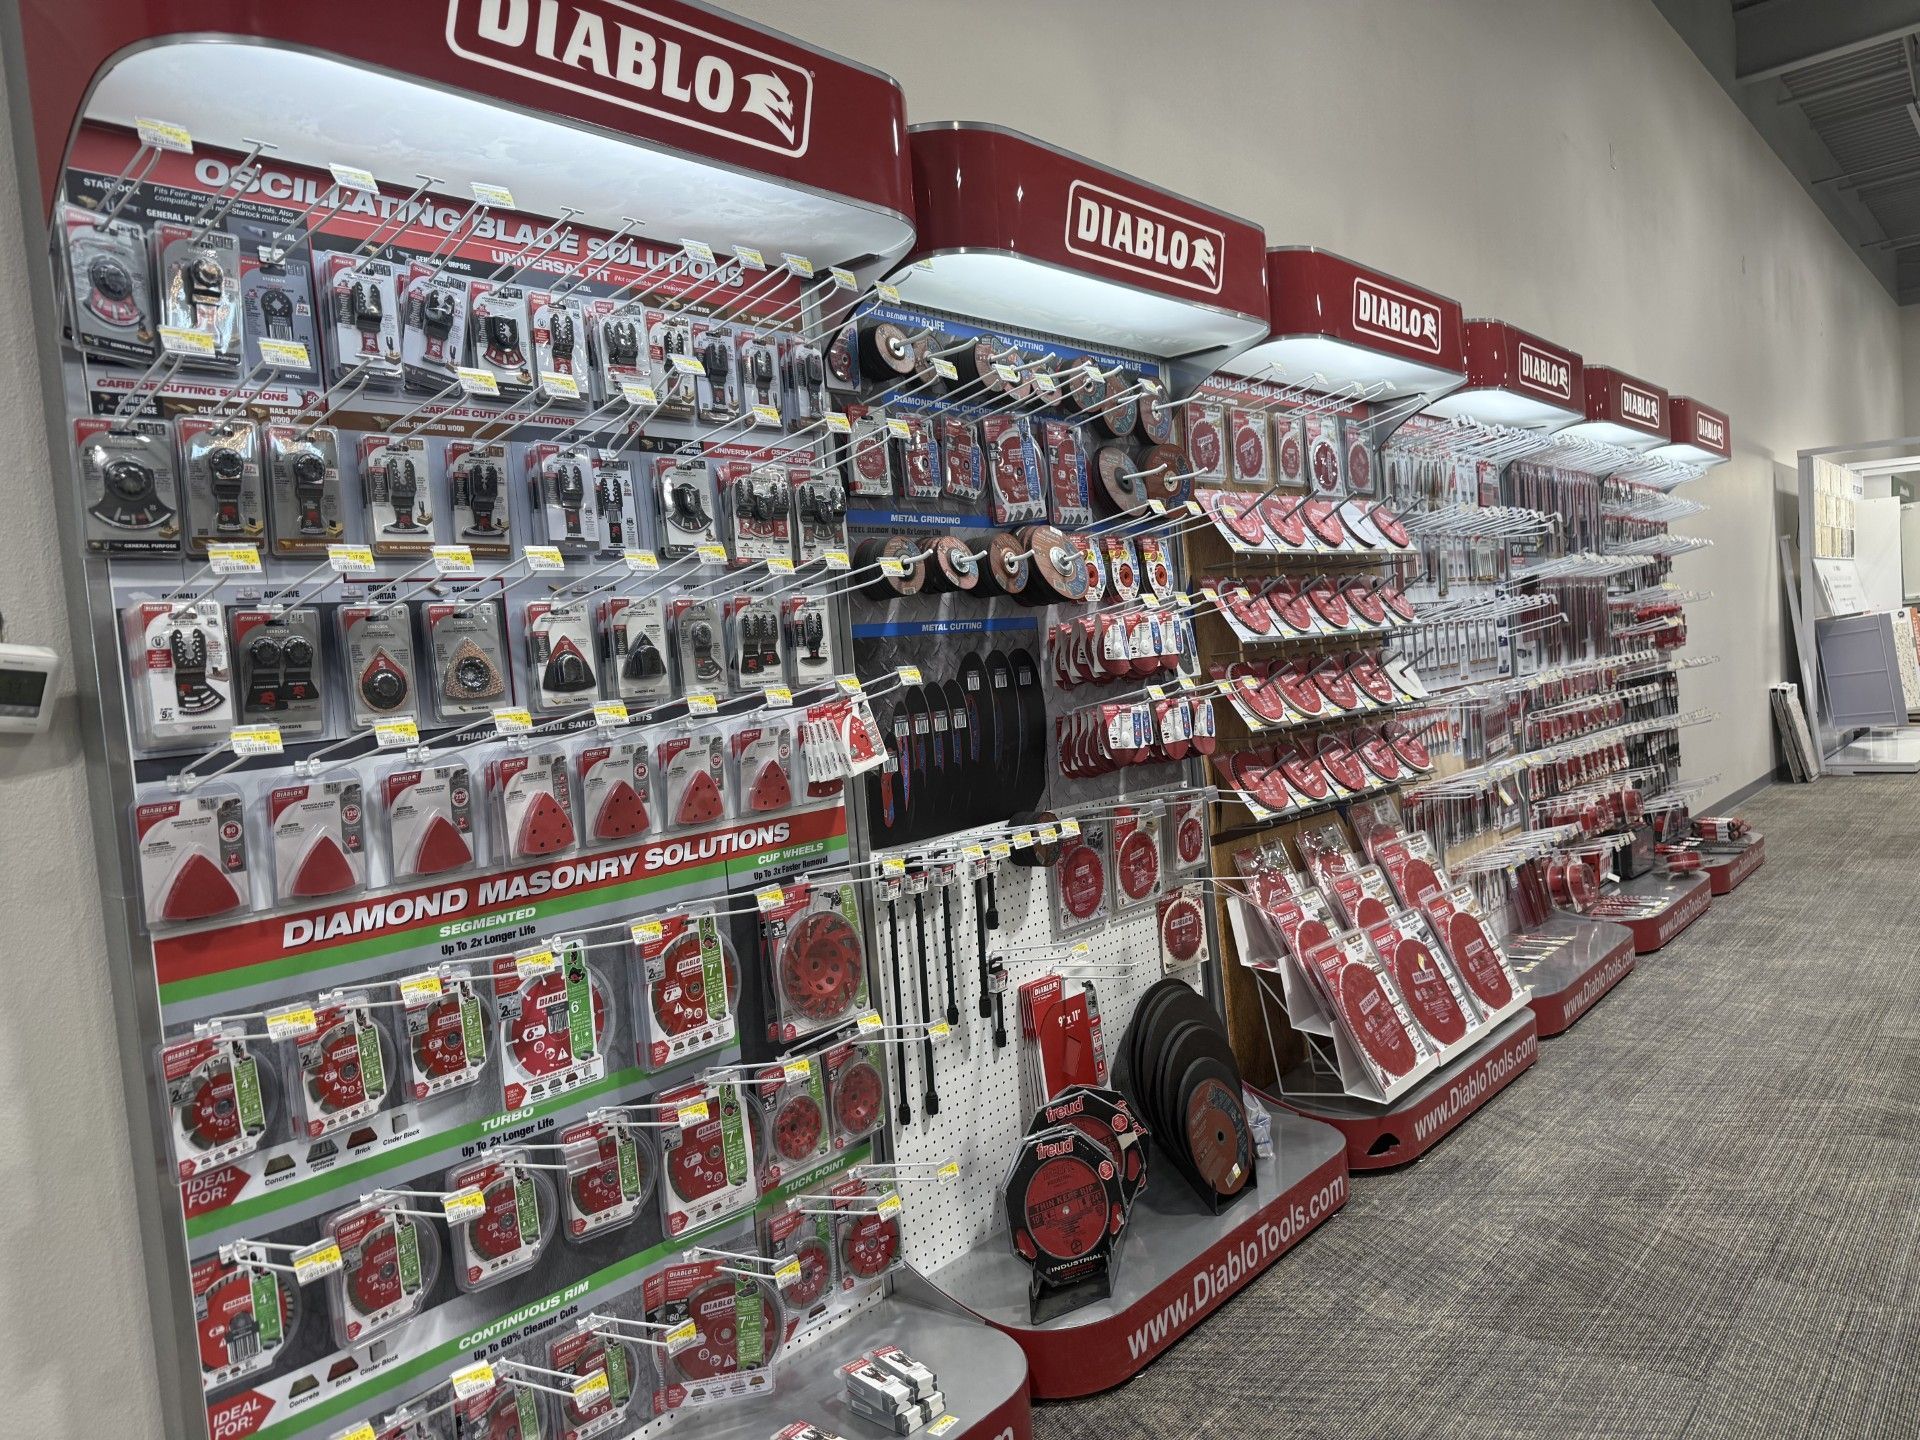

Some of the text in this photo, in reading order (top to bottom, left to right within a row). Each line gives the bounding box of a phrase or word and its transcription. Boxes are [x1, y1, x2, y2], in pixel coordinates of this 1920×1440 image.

[477, 0, 735, 114] DIABLO
[146, 208, 183, 223] GENERAL
[154, 186, 170, 197] Fits
[279, 209, 294, 218] Also
[195, 158, 745, 288] OSCILLATING BLADE SOLUTIONS
[1078, 196, 1189, 270] DIABLO
[492, 250, 585, 278] UNIVERSAL
[931, 320, 945, 332] LIFE
[1359, 289, 1422, 338] DIABLO
[1013, 338, 1044, 352] CUTTING
[1521, 351, 1558, 388] DIABLO
[1623, 390, 1651, 419] DIABLO
[1698, 417, 1718, 441] DIABLO
[890, 514, 961, 525] METAL GRINDING
[921, 621, 982, 633] METAL CUTTING
[276, 790, 298, 798] DIABLO
[141, 805, 167, 816] DIABLO
[225, 826, 237, 836] 80
[753, 856, 829, 881] Up To 3x Faster Removal
[282, 823, 791, 949] DIAMOND MASONRY SOLUTIONS
[439, 842, 825, 938] SEGMENTED CUP WHEELS
[441, 924, 537, 955] Up To 2x Longer Life
[679, 958, 701, 971] DIABLO
[1034, 982, 1053, 997] DIABLO
[1563, 948, 1636, 1020] www.DiabloTools.com
[539, 991, 567, 1008] DIABLO
[167, 1047, 190, 1061] DIABLO
[1414, 1034, 1537, 1142] www.DiabloTools.com
[481, 1107, 534, 1131] TURBO
[1046, 1094, 1085, 1124] freud
[461, 1118, 555, 1157] Up To 2x Longer Life
[1036, 1135, 1075, 1161] freud
[264, 1171, 296, 1186] Concrete
[354, 1145, 371, 1156] Brick
[382, 1134, 400, 1146] Cinder
[401, 1128, 420, 1141] Block
[186, 1168, 236, 1195] IDEAL
[784, 1157, 846, 1194] TUCK POINT
[188, 1187, 228, 1209] FOR:
[669, 1270, 692, 1279] DIABLO
[1051, 1252, 1103, 1273] INDUSTRIAL
[1126, 1175, 1344, 1360] www.DiabloTools.com
[458, 1281, 590, 1350] CONTINUOUS RIM
[703, 1297, 733, 1312] DIABLO
[473, 1305, 578, 1362] Up To 60% Cleaner Cuts
[289, 1354, 399, 1409] Concrete Brick Cinder Block
[213, 1398, 262, 1429] IDEAL
[213, 1416, 254, 1440] FOR:
